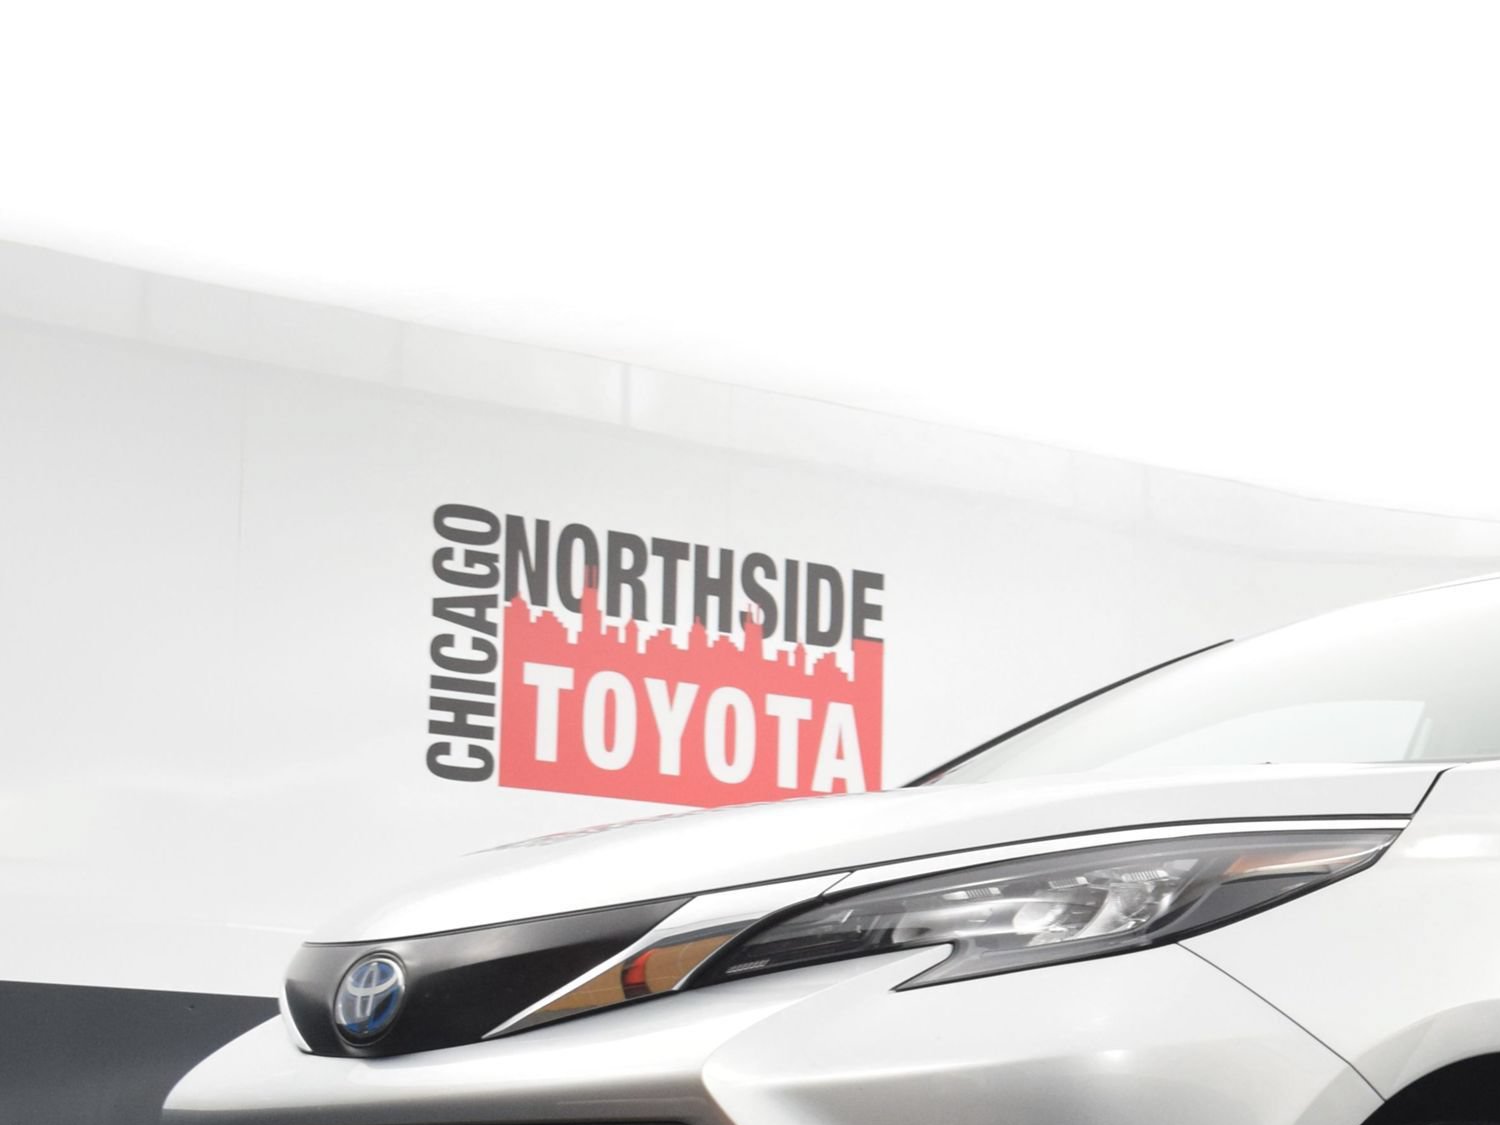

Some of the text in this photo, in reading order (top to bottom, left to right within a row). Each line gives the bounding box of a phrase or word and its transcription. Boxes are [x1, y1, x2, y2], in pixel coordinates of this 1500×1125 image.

[426, 503, 501, 783] CHICAGO
[504, 513, 885, 649] NORTHSIDE
[522, 661, 866, 794] TOYOTA
